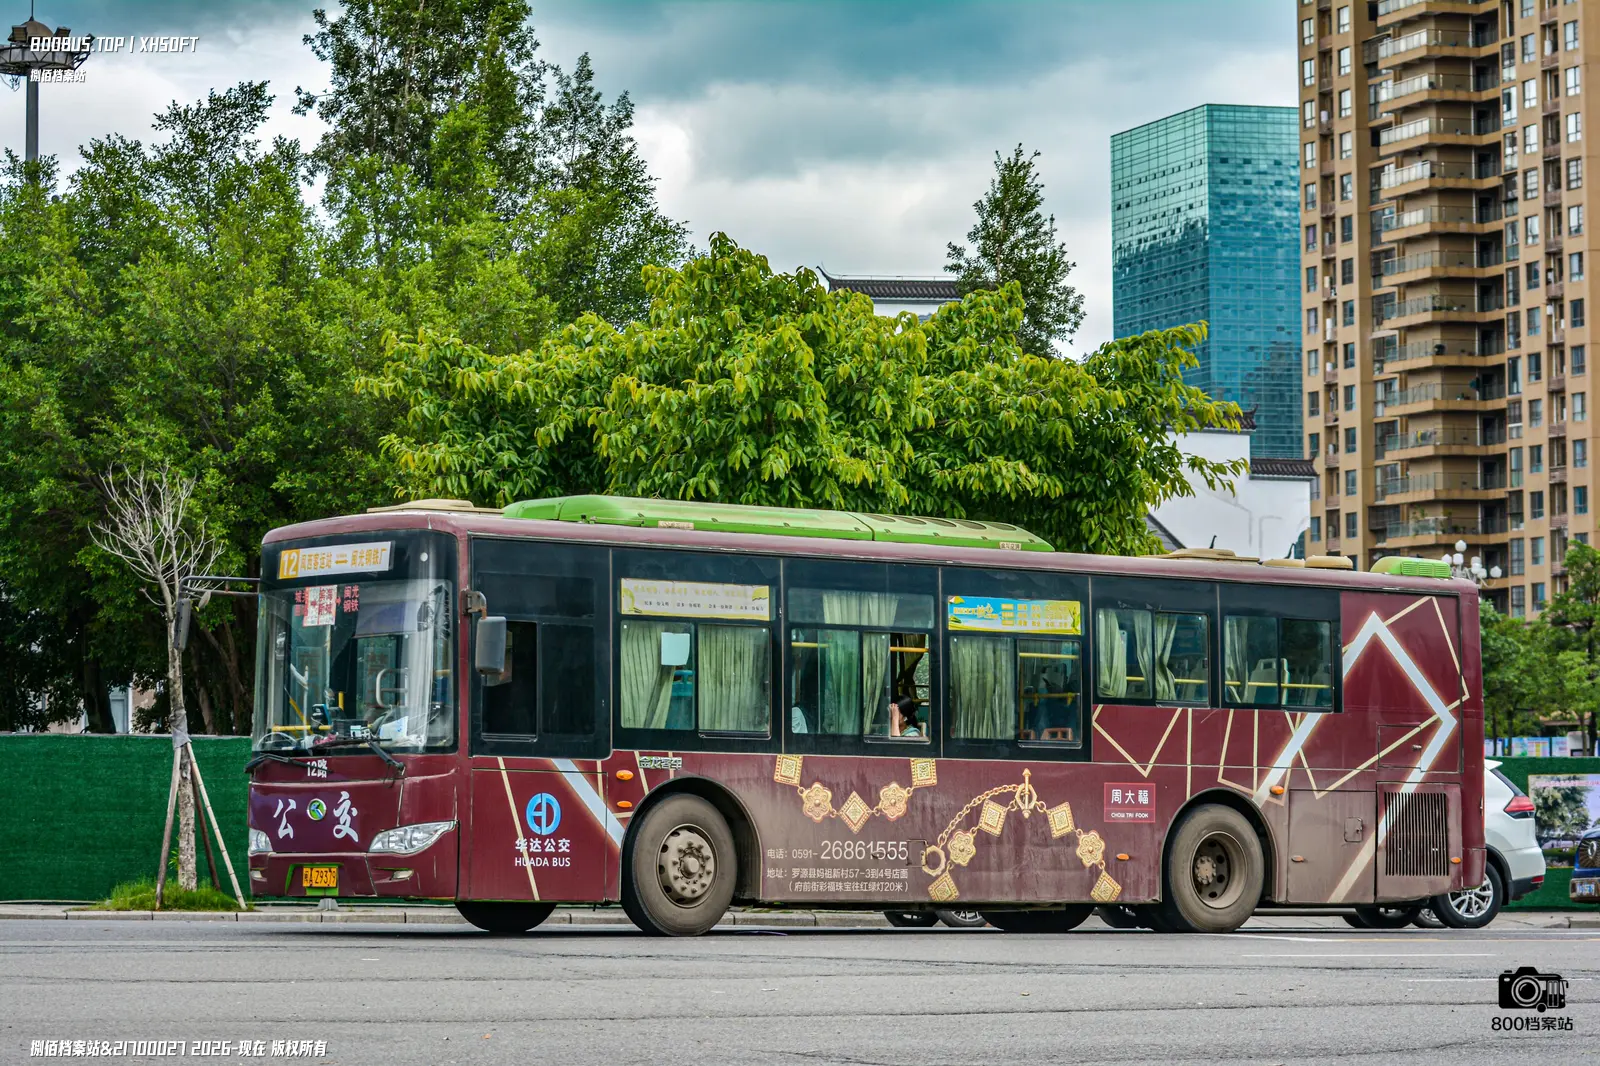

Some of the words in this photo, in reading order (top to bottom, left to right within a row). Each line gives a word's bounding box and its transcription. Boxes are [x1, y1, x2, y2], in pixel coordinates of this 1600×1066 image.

[282, 552, 298, 576] 12
[306, 758, 328, 778] 12路
[639, 756, 682, 770] 金龙客车
[1111, 789, 1149, 804] 周大福
[515, 838, 571, 853] 华达公交
[515, 857, 549, 867] HUADA
[552, 857, 571, 867] BUS
